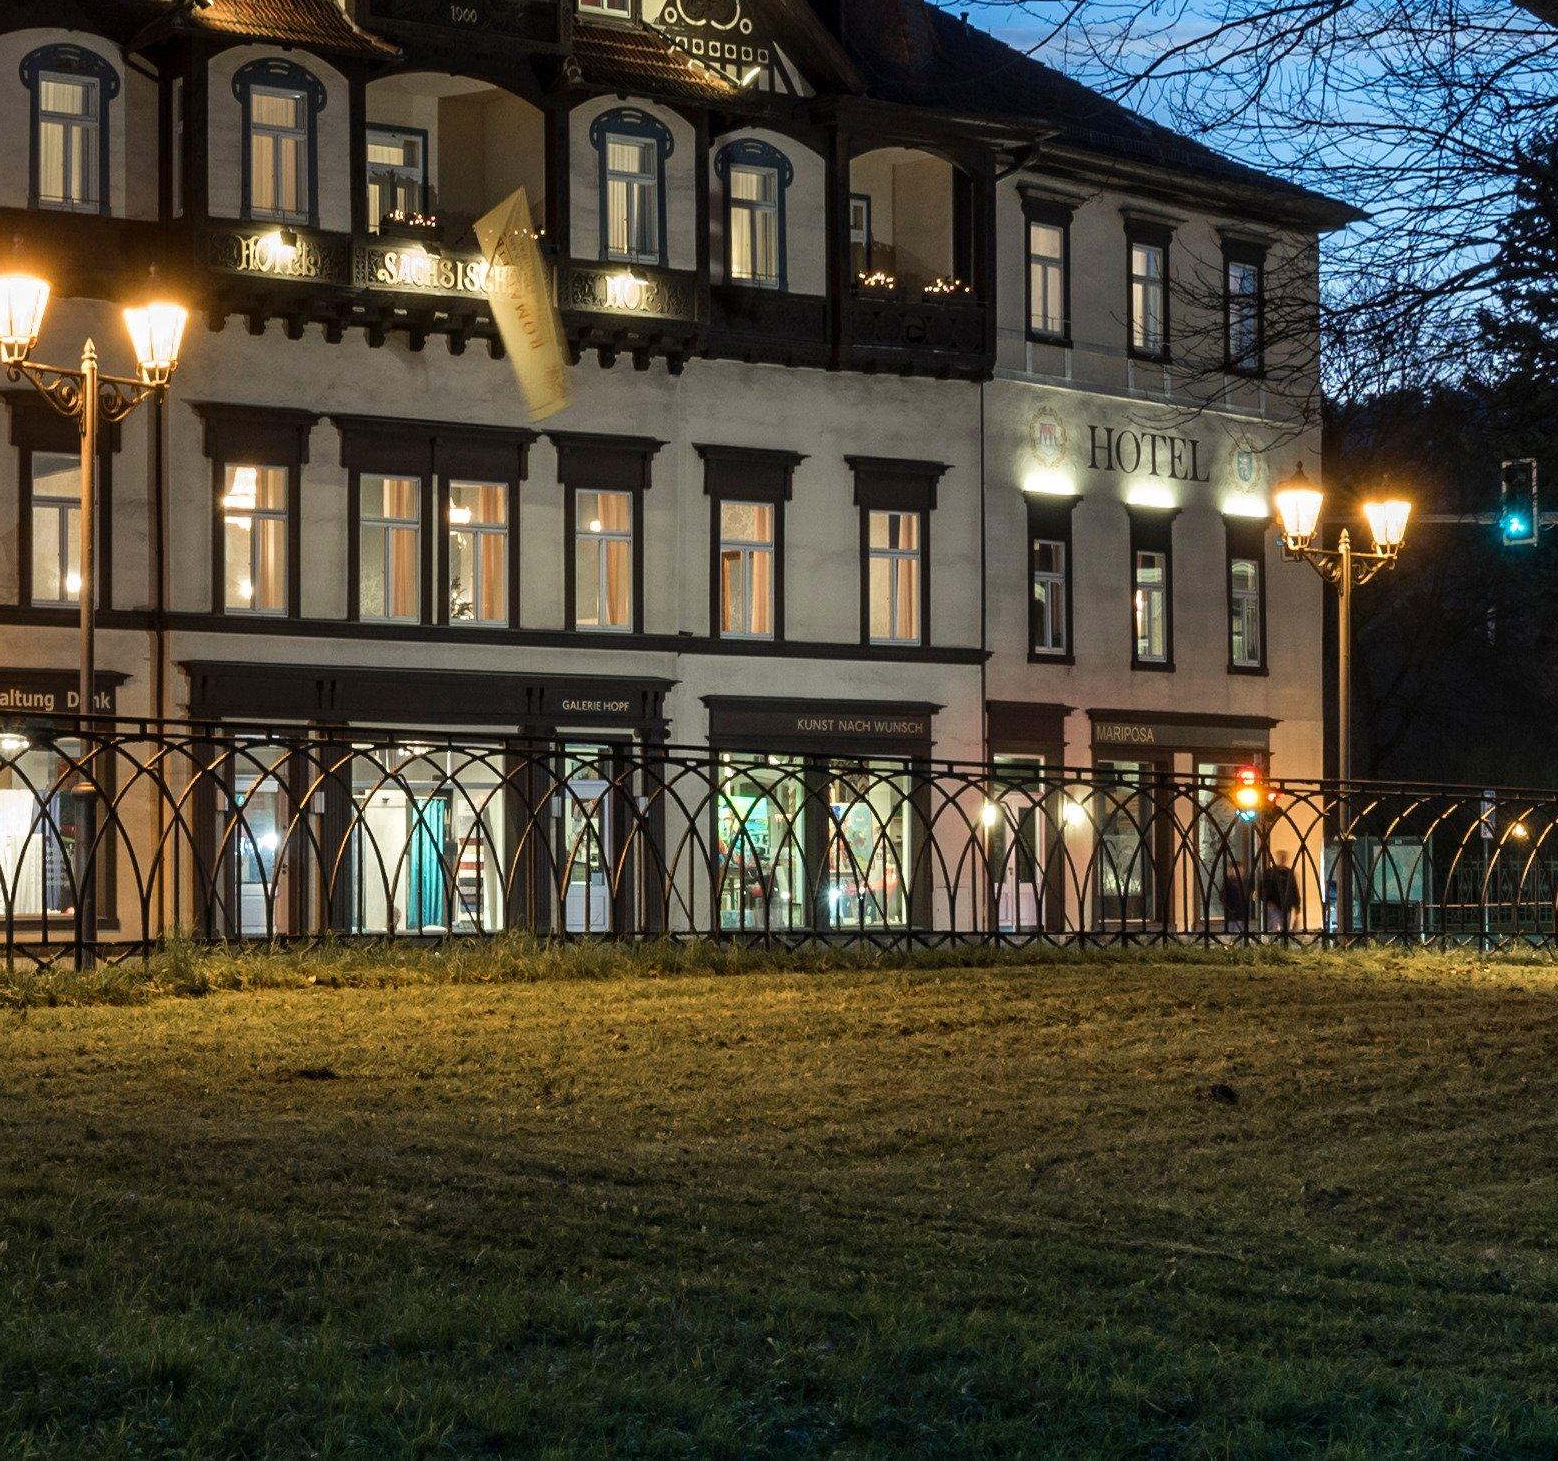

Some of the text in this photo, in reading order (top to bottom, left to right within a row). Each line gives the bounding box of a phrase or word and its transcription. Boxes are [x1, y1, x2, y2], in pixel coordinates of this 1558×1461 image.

[451, 5, 477, 23] 1900
[1087, 425, 1210, 482] HOTEL
[67, 691, 111, 710] Dnk
[562, 700, 630, 712] GALERIE HOPF
[797, 719, 923, 734] KUNST NACH WUNSCH
[1096, 725, 1155, 743] MARIPOSA
